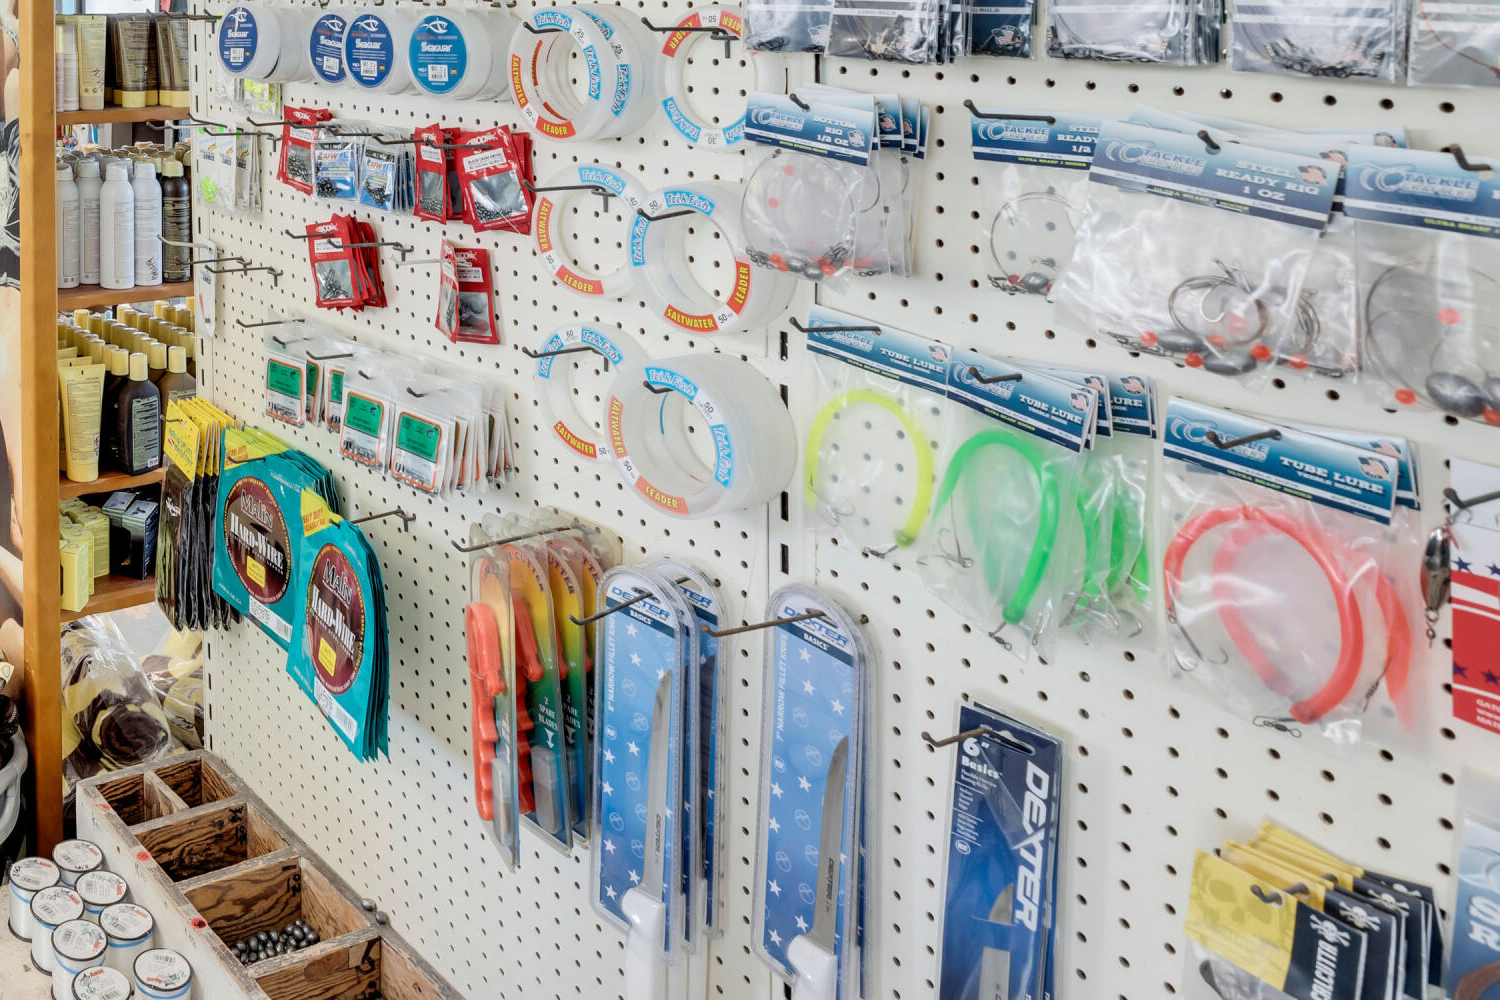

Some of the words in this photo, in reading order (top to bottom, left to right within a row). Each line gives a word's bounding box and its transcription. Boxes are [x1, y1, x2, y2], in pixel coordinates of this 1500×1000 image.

[575, 27, 585, 39] 25
[511, 56, 526, 106] SALTWATER
[542, 122, 569, 136] LEADER
[1003, 125, 1050, 136] TACKLE
[369, 161, 383, 169] AFW
[1143, 149, 1206, 168] TACKLE
[1235, 160, 1296, 179] STEEL
[1216, 168, 1279, 187] READY
[1284, 181, 1320, 196] RIG
[1242, 185, 1251, 194] 1
[1257, 188, 1286, 201] OZ
[1404, 173, 1479, 190] TACKLE
[648, 199, 658, 211] 50
[539, 200, 550, 250] SALTWATER
[545, 254, 555, 265] 50
[563, 273, 594, 294] LEADER
[734, 265, 749, 305] LEADER
[666, 307, 715, 330] SALTWATER
[717, 313, 728, 324] 50
[565, 328, 575, 338] 60
[879, 348, 911, 365] TUBE
[912, 358, 945, 374] LURE
[703, 401, 714, 414] 50
[1018, 394, 1049, 410] TUBE
[1050, 406, 1083, 425] LURE
[555, 423, 594, 456] SALTWATER
[611, 400, 625, 456] SALTWATER
[622, 460, 633, 472] 50
[1279, 455, 1330, 478] TUBE
[1333, 471, 1385, 495] LURE
[1296, 470, 1334, 486] TREBLE
[1333, 482, 1363, 495] HOOK
[645, 484, 679, 509] LEADER
[230, 511, 284, 570] HARD-WIRE
[311, 583, 356, 654] HARD-WIRE
[629, 610, 652, 625] BASICS
[803, 633, 828, 651] BASICS
[607, 664, 615, 702] NARROW
[778, 661, 787, 691] FILLET
[543, 696, 549, 706] 2
[566, 694, 572, 703] 2
[537, 714, 559, 732] BLADES
[538, 702, 557, 721] SPARE
[776, 691, 786, 732] NARROW
[961, 754, 1001, 780] Basics
[654, 813, 662, 856] DEXTER
[1012, 759, 1050, 932] DEXTER
[825, 857, 835, 903] DEXTER
[1311, 940, 1338, 1000] CALCUTTA
